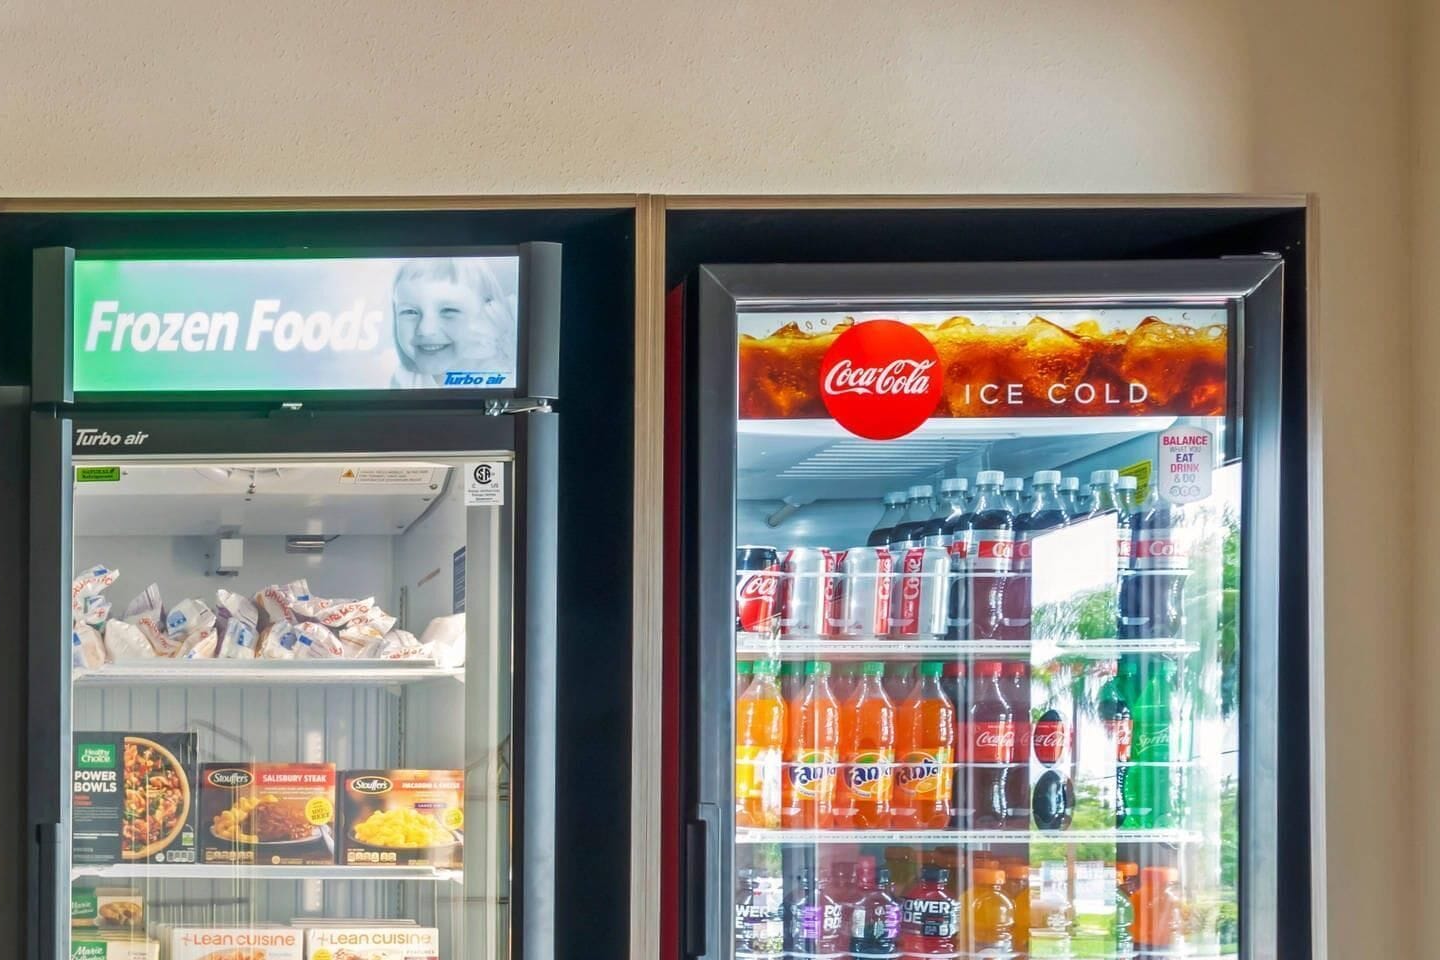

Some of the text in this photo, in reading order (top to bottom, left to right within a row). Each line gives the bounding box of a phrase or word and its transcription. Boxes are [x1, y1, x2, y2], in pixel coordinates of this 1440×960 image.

[84, 298, 384, 353] Frozen Foods
[444, 372, 507, 386] Turbo air
[824, 359, 937, 395] Coca-Cola
[964, 382, 1150, 405] ICE COLD
[75, 429, 149, 447] Turbo air
[1163, 436, 1208, 446] BALANCE
[1176, 453, 1194, 463] EAT
[1170, 463, 1200, 473] DRINK
[74, 771, 116, 781] POWER
[262, 774, 327, 783] SALISBURY STEAK
[73, 782, 117, 793] BOWLS
